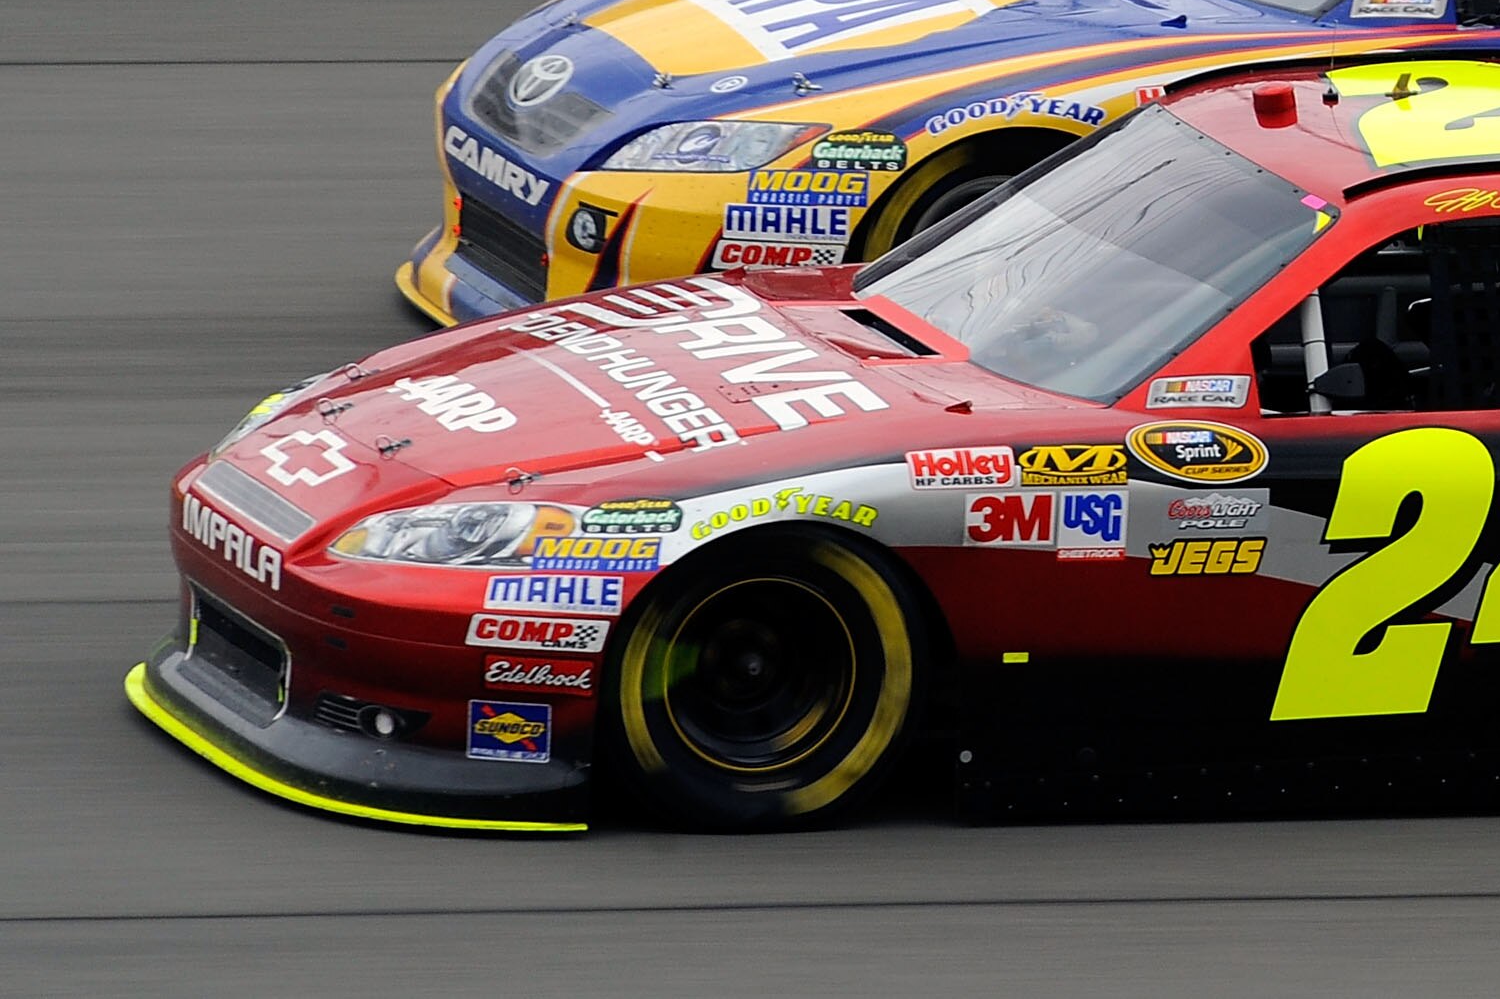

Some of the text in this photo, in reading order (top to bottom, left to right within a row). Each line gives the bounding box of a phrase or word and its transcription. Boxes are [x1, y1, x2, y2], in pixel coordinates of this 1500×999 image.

[1403, 5, 1436, 14] CAR
[925, 92, 1106, 136] GOODYEAR
[813, 141, 904, 161] Gatorback
[444, 125, 550, 206] CAMRY
[817, 159, 899, 170] BELTS
[750, 171, 867, 193] MOOG
[752, 193, 860, 205] CHASSIS PARTS
[726, 205, 847, 236] MAHLE
[720, 243, 813, 267] COMP
[529, 321, 624, 354] END
[586, 348, 742, 453] HUNGER
[1185, 379, 1232, 392] NASCAR
[386, 375, 518, 433] AARP
[1154, 394, 1237, 404] RACE CAR
[1166, 430, 1213, 443] NASCAR
[1175, 444, 1221, 462] Sprint
[911, 450, 1010, 484] Holley
[1185, 465, 1250, 475] CUP SERIES
[916, 476, 994, 487] HP CARBS
[1021, 472, 1128, 485] MECHANIX WEAR
[582, 508, 680, 524] Gatorback
[690, 491, 879, 541] GOODYEAR
[968, 494, 1052, 543] 3M
[1064, 493, 1123, 542] USG
[1168, 498, 1262, 520] Coors LIGHT
[586, 524, 673, 533] BELTS
[1178, 518, 1247, 530] POLE
[183, 493, 282, 591] IMPALA
[537, 538, 660, 559] MOOG
[537, 558, 652, 570] CHASSIS PARTS
[1150, 539, 1265, 576] JEGS
[489, 576, 619, 606] MAHLE
[476, 617, 574, 643] COMP
[541, 639, 588, 650] CAMS
[484, 660, 593, 689] Edelbrock
[477, 720, 542, 735] SUNOCO
